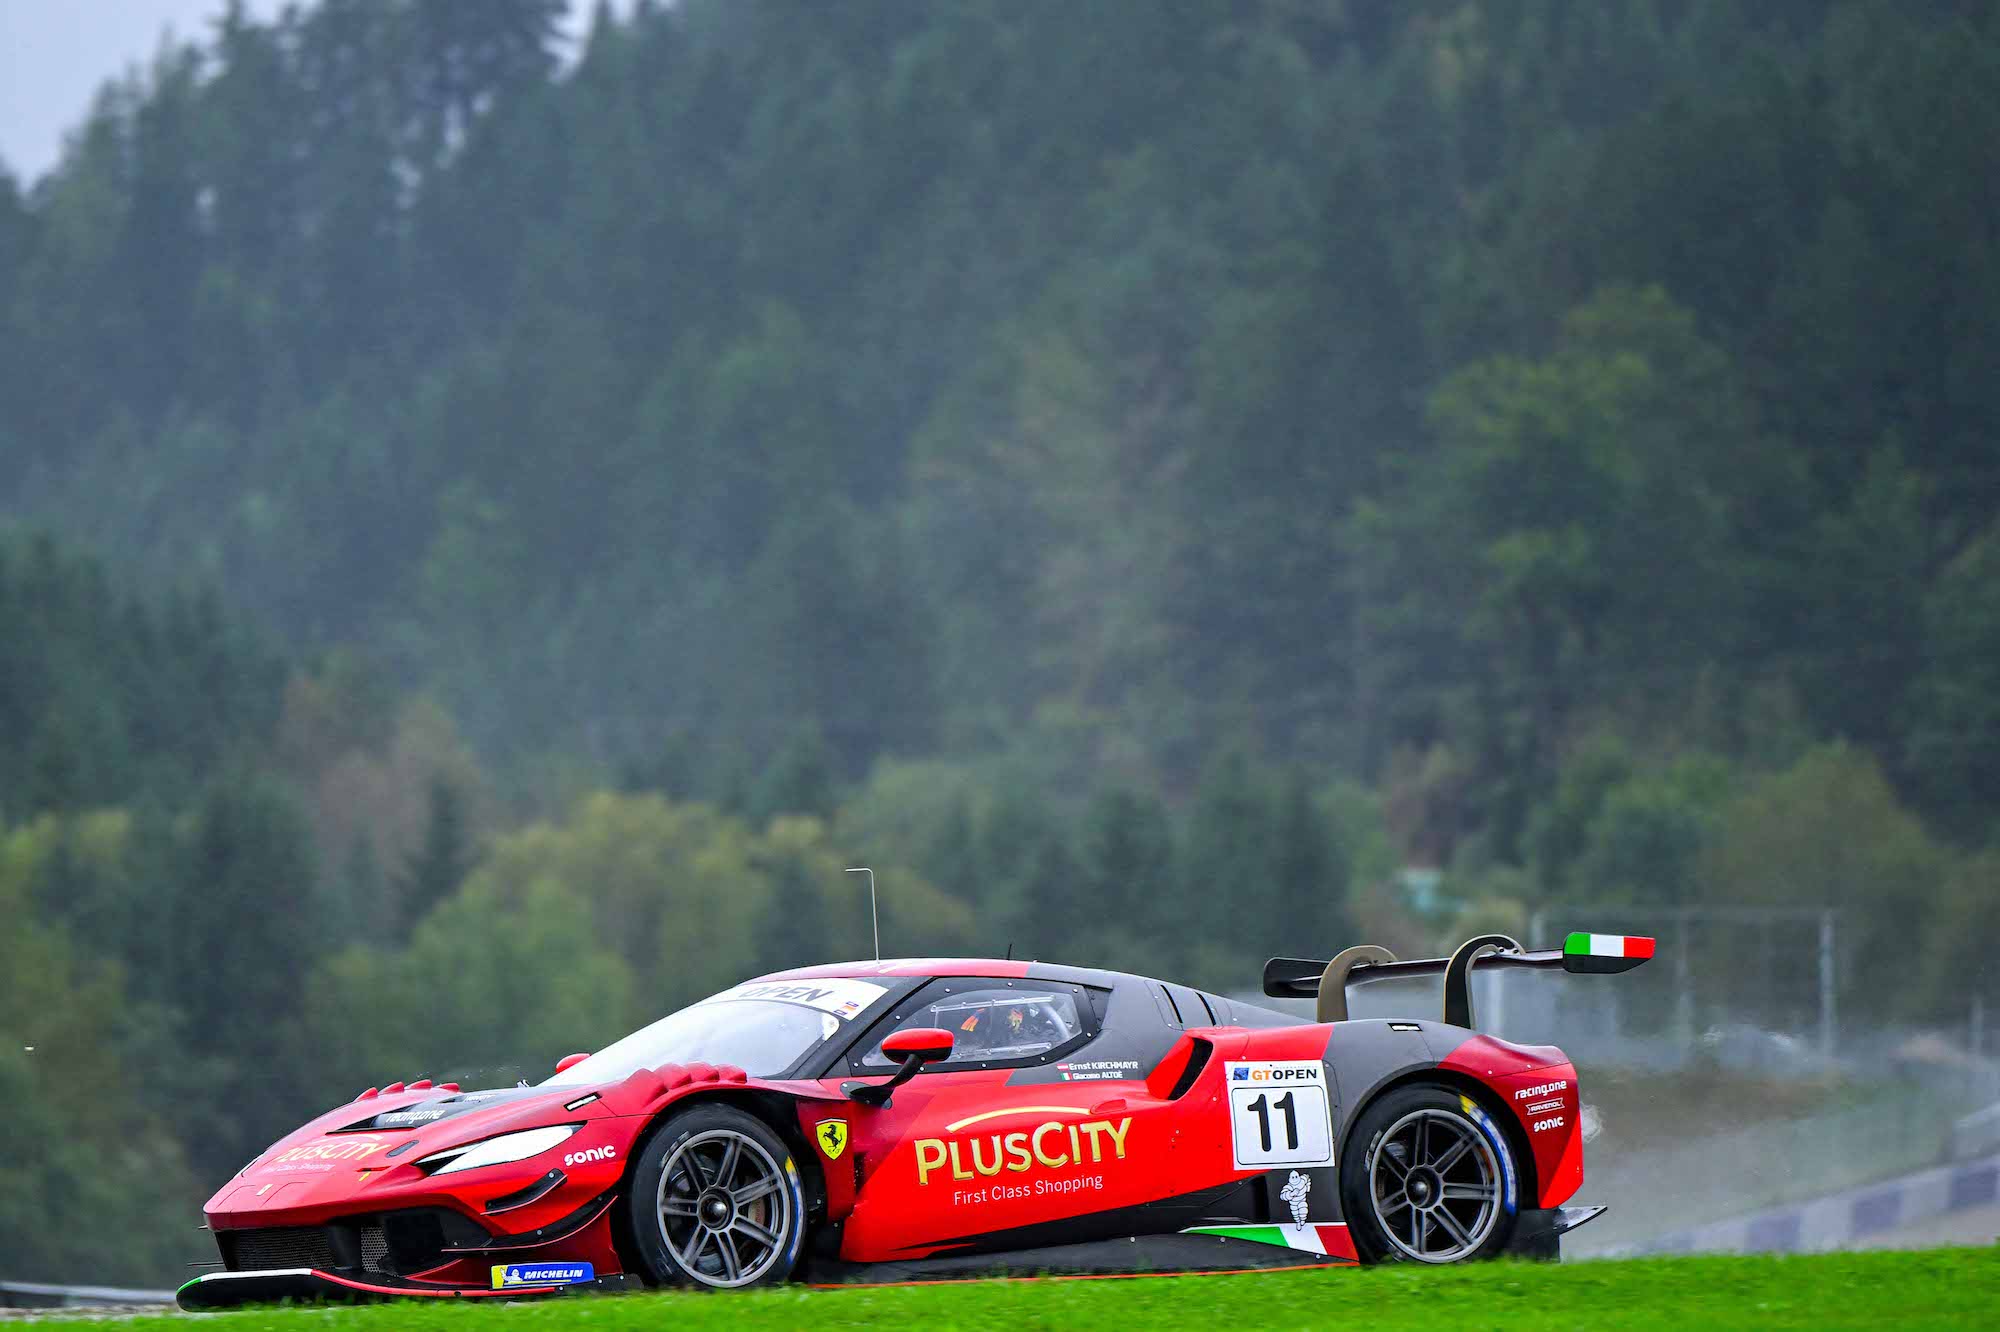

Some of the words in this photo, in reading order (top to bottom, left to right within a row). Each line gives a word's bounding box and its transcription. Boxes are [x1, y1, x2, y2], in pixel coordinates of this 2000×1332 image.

[739, 986, 834, 1002] OPEN
[1068, 1062, 1092, 1071] Ernst
[1092, 1061, 1139, 1070] KIRCHMAYR
[1514, 1080, 1567, 1100] racing.one
[1247, 1091, 1299, 1152] 11
[914, 1117, 1133, 1185] PLUSCITY
[954, 1187, 987, 1205] First
[991, 1184, 1031, 1201] Class
[1035, 1174, 1104, 1196] Shopping
[523, 1269, 584, 1280] MICHELIN
